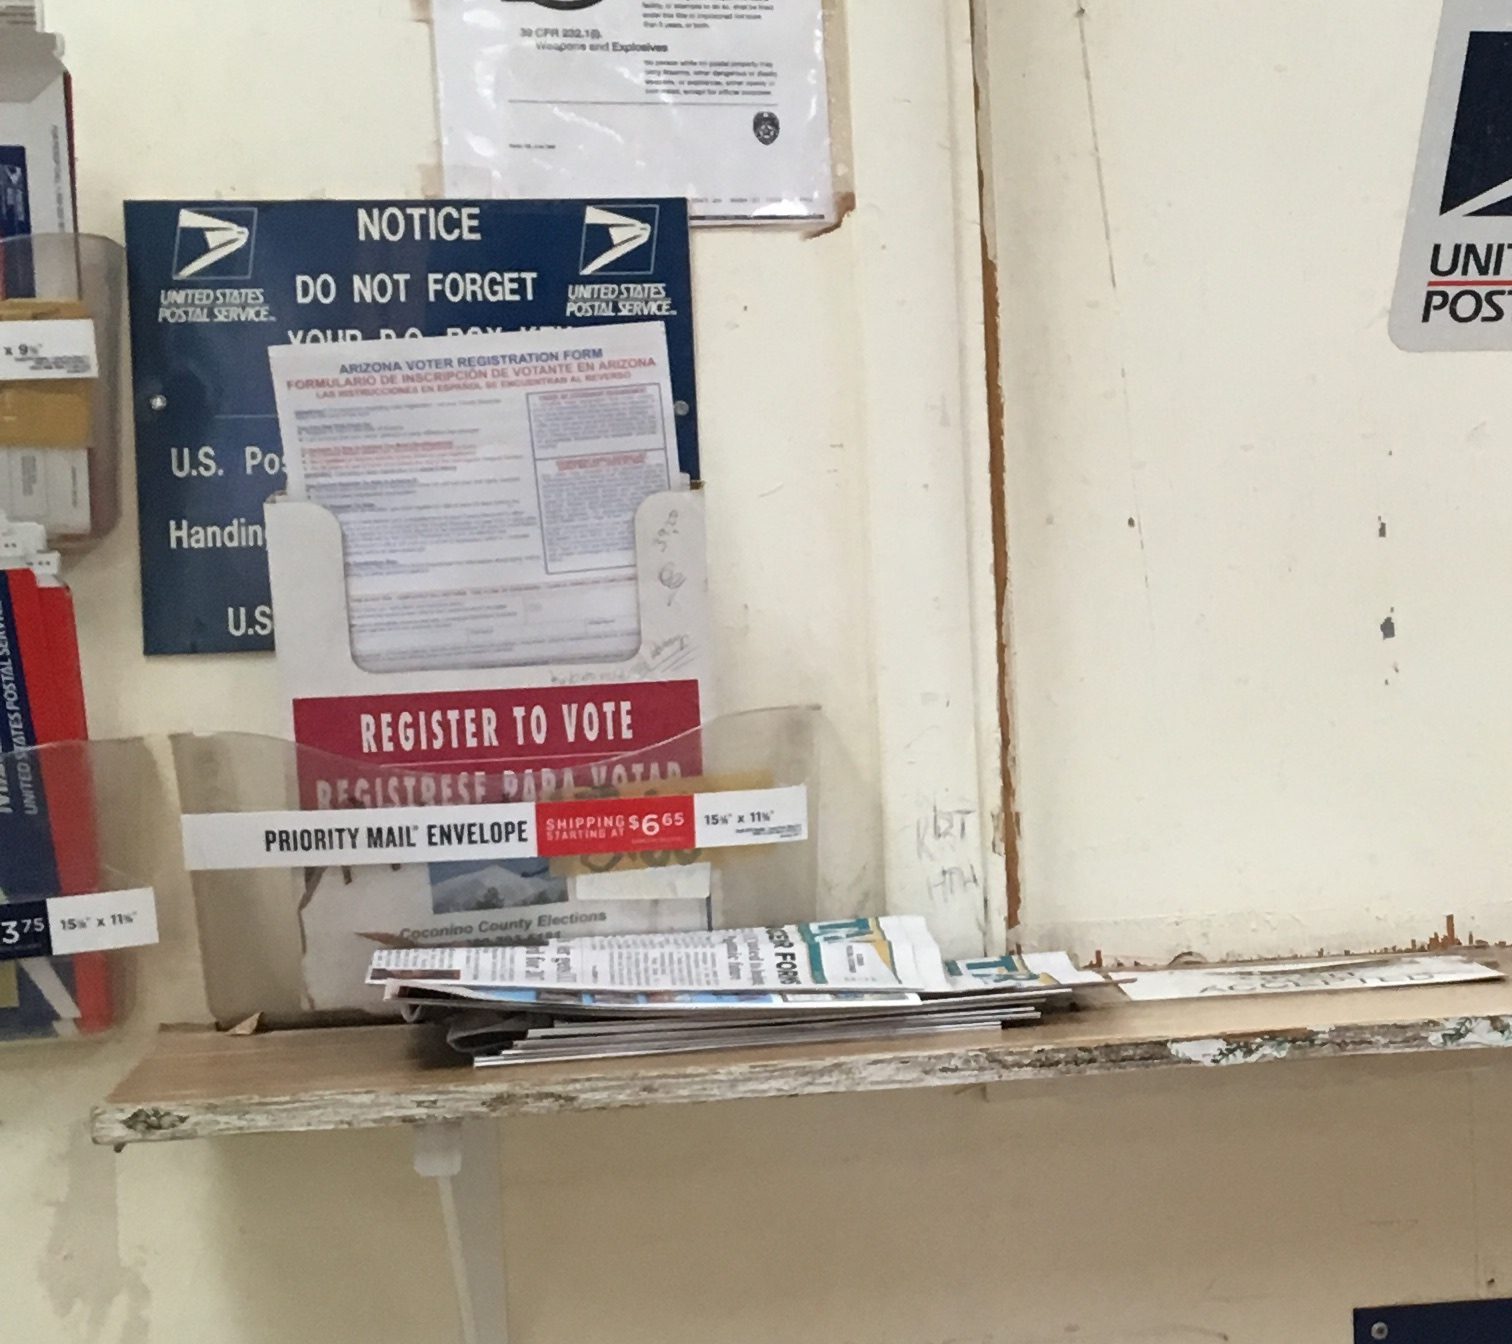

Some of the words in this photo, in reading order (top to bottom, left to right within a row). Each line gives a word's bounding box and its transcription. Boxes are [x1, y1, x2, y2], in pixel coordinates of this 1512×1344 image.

[357, 207, 482, 242] NOTICE
[160, 289, 214, 305] UNITED
[216, 288, 265, 304] STATES
[295, 274, 336, 304] DO
[353, 273, 410, 304] NOT
[429, 272, 538, 303] FORGET
[157, 306, 212, 323] POSTAL
[339, 360, 403, 375] ARIZONA
[405, 357, 453, 372] VOTER
[457, 351, 560, 368] REGISTRATION
[563, 348, 604, 362] FORM
[170, 446, 225, 478] U.S.
[1, 661, 22, 707] POSTAL
[8, 710, 31, 763] STATES
[359, 709, 499, 754] REGISTER
[512, 705, 548, 746] TO
[562, 701, 634, 744] VOTE
[17, 761, 39, 816] UNITED
[264, 828, 358, 853] PRIORITY
[427, 820, 529, 847] ENVELOPE
[546, 814, 625, 831] SHIPPING
[546, 828, 606, 842] STARTING
[610, 826, 625, 838] AT
[401, 923, 474, 941] Coconino
[478, 916, 533, 935] County
[537, 910, 607, 928] Elections
